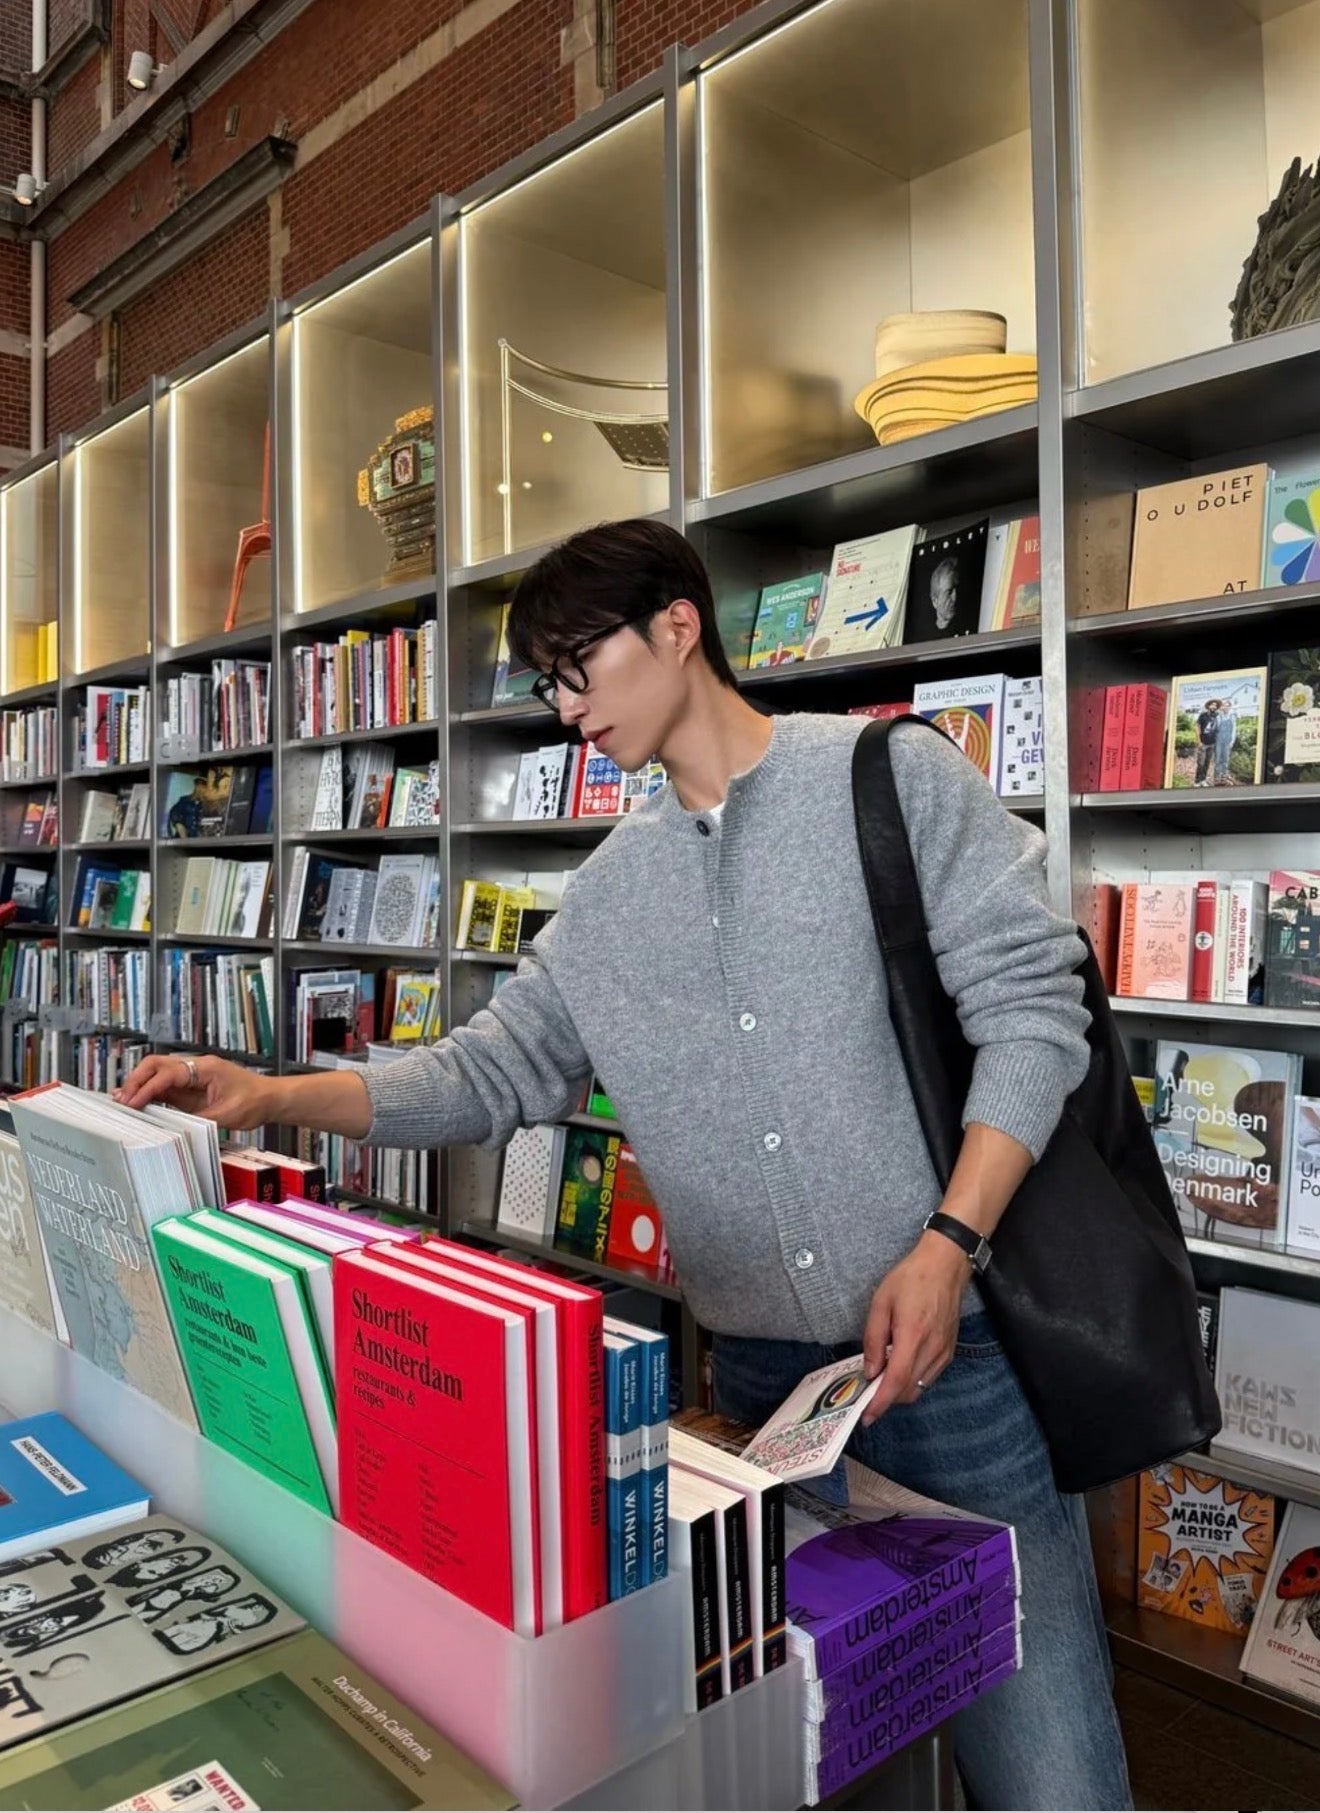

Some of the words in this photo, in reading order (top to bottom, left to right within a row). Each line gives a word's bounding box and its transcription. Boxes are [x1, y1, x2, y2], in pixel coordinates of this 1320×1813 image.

[1203, 475, 1254, 495] PIET
[1274, 485, 1288, 494] The
[1223, 580, 1248, 594] AT
[919, 687, 959, 702] GRAPHIC
[960, 684, 996, 697] DESIGN
[1230, 894, 1239, 933] AROUND
[1239, 907, 1247, 924] 100
[1229, 933, 1237, 949] THE
[1236, 924, 1246, 970] INTERIORS
[1227, 950, 1236, 983] WORLD
[1162, 1072, 1215, 1097] Arne
[1160, 1099, 1268, 1132] Jacobsen
[1159, 1143, 1272, 1184] Designing
[26, 1151, 128, 1226] NEDERLAND
[36, 1191, 141, 1272] WATERLAND
[168, 1255, 225, 1301] Shortlist
[179, 1288, 258, 1345] Amsterdam
[352, 1286, 429, 1348] Shortlist
[353, 1325, 463, 1402] Amsterdam
[588, 1323, 601, 1408] Shortlist
[353, 1366, 405, 1401] restaurants
[406, 1389, 417, 1408] &
[353, 1383, 385, 1410] recipes
[1224, 1392, 1279, 1422] NEW
[1225, 1371, 1297, 1407] KAWS
[1224, 1412, 1320, 1456] FICTION
[588, 1415, 602, 1527] Amsterdam
[1171, 1507, 1238, 1529] MANGA
[1177, 1525, 1233, 1542] ARTIST
[847, 1549, 978, 1648] Amsterdam
[853, 1586, 983, 1688] Amsterdam
[1266, 1638, 1298, 1657] STREET
[850, 1623, 982, 1729] Amsterdam
[333, 1675, 378, 1714] Duchamp
[373, 1709, 388, 1723] in
[383, 1719, 432, 1762] California
[848, 1660, 984, 1768] Amsterdam
[205, 1769, 246, 1811] WANTED
